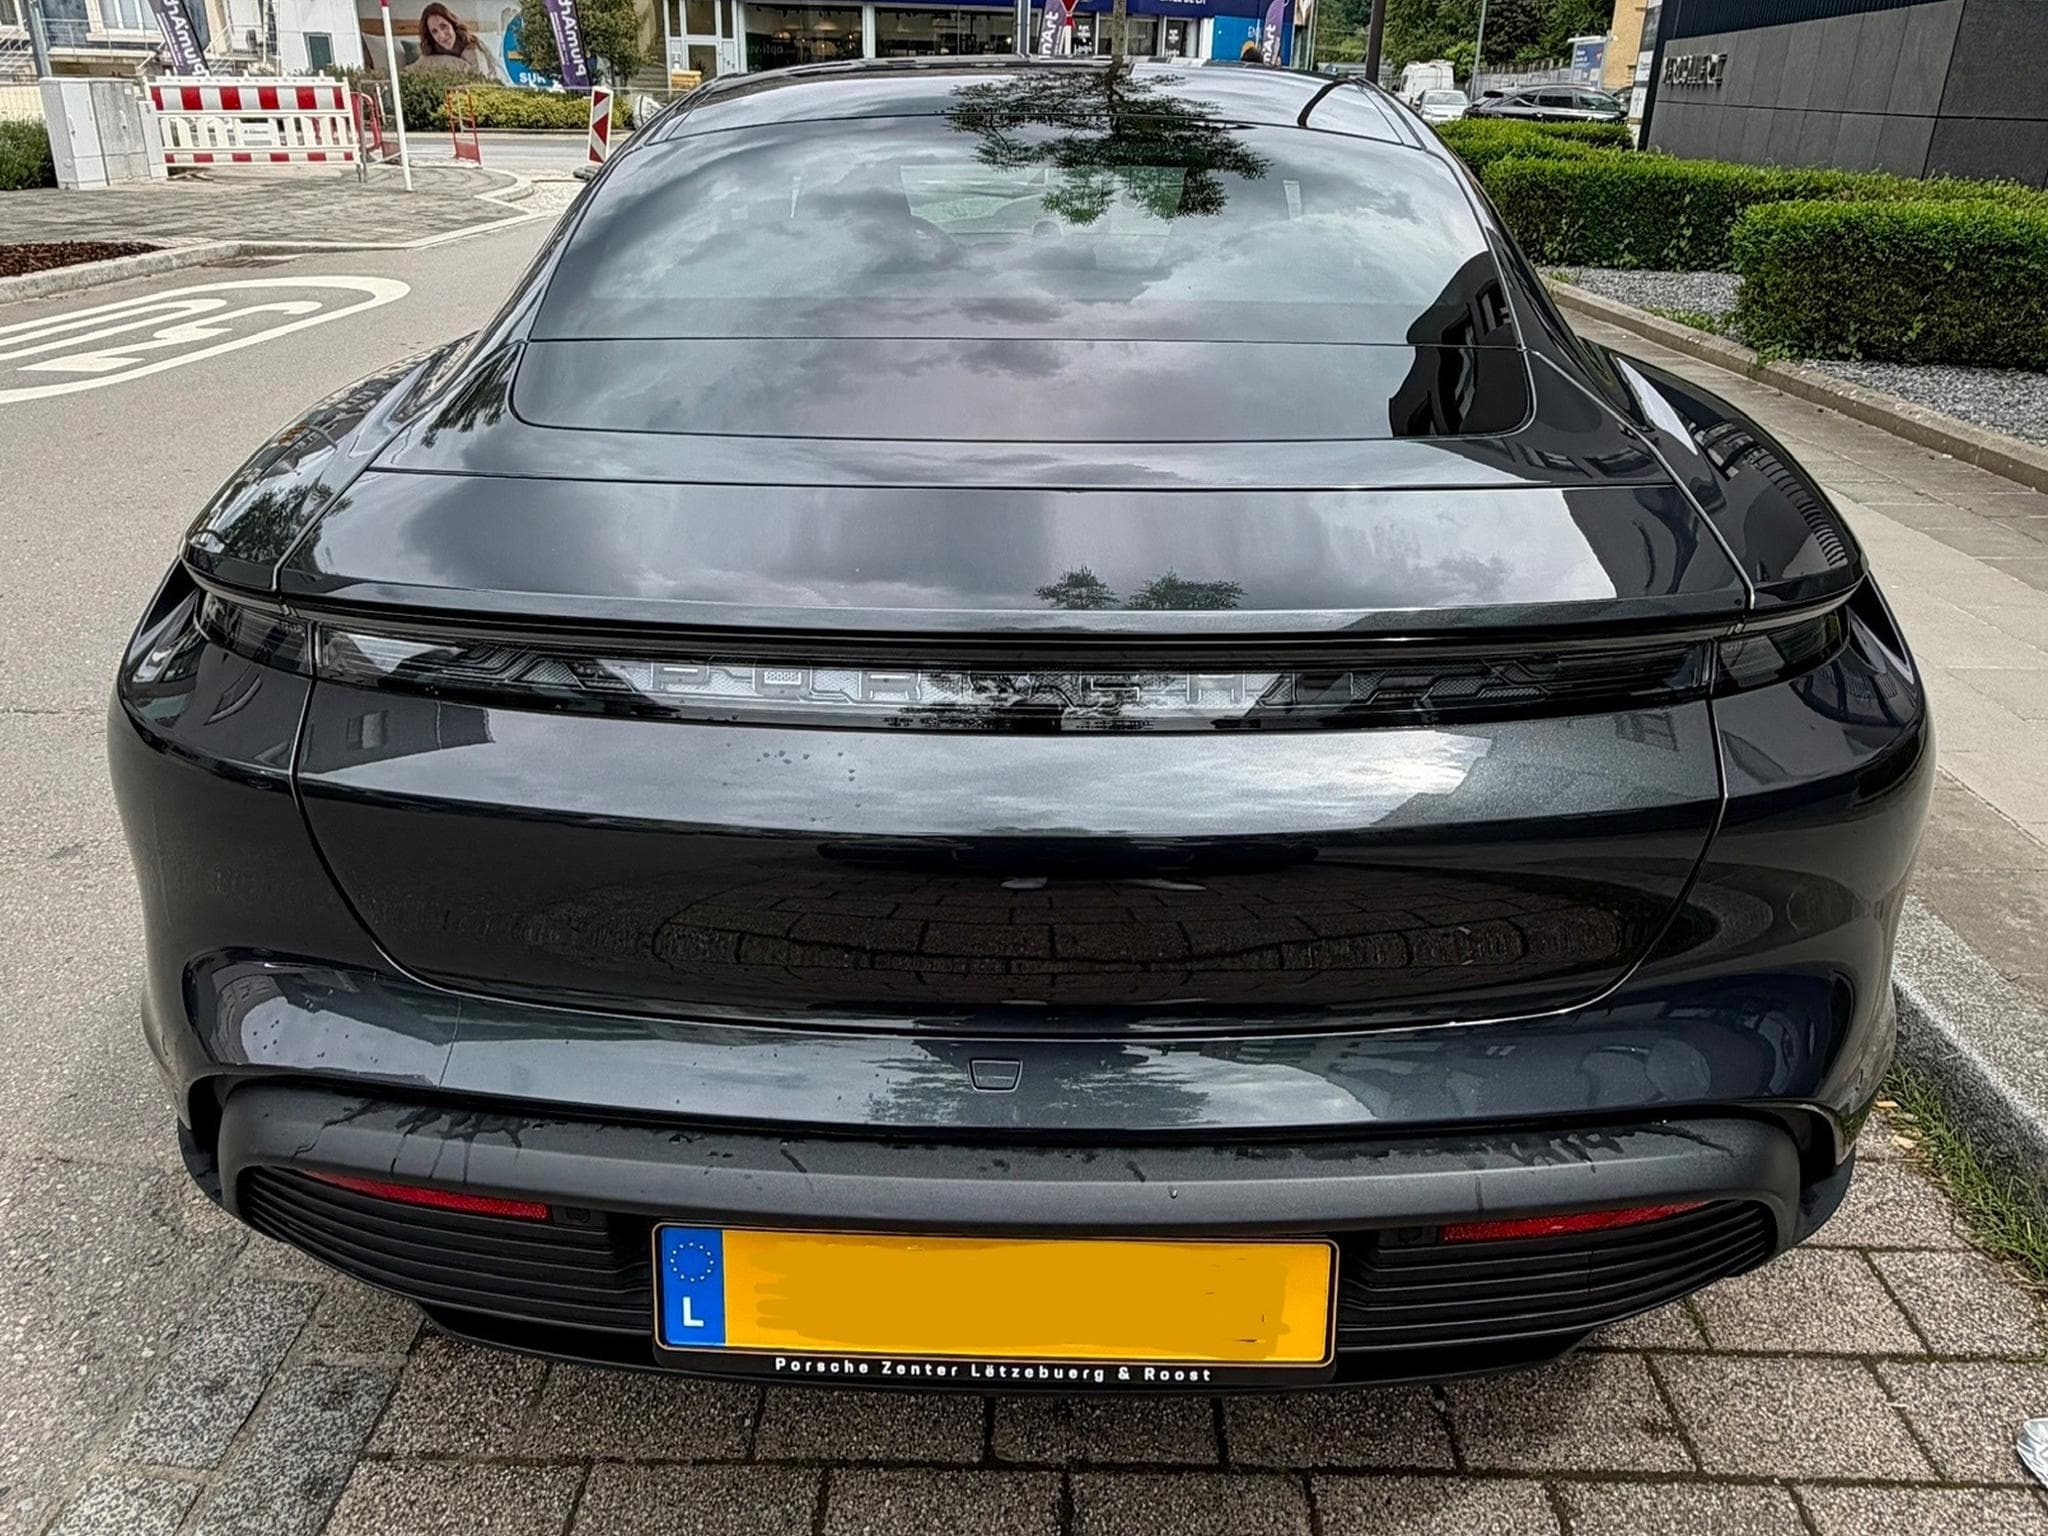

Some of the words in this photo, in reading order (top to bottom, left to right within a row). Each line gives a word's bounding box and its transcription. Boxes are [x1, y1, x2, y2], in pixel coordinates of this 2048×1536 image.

[682, 1296, 704, 1327] L
[775, 1357, 869, 1375] Porsche
[881, 1360, 958, 1377] Zenter
[970, 1363, 1104, 1383] Lëtzebuerg
[1117, 1366, 1131, 1381] &
[1144, 1367, 1211, 1382] Roost
